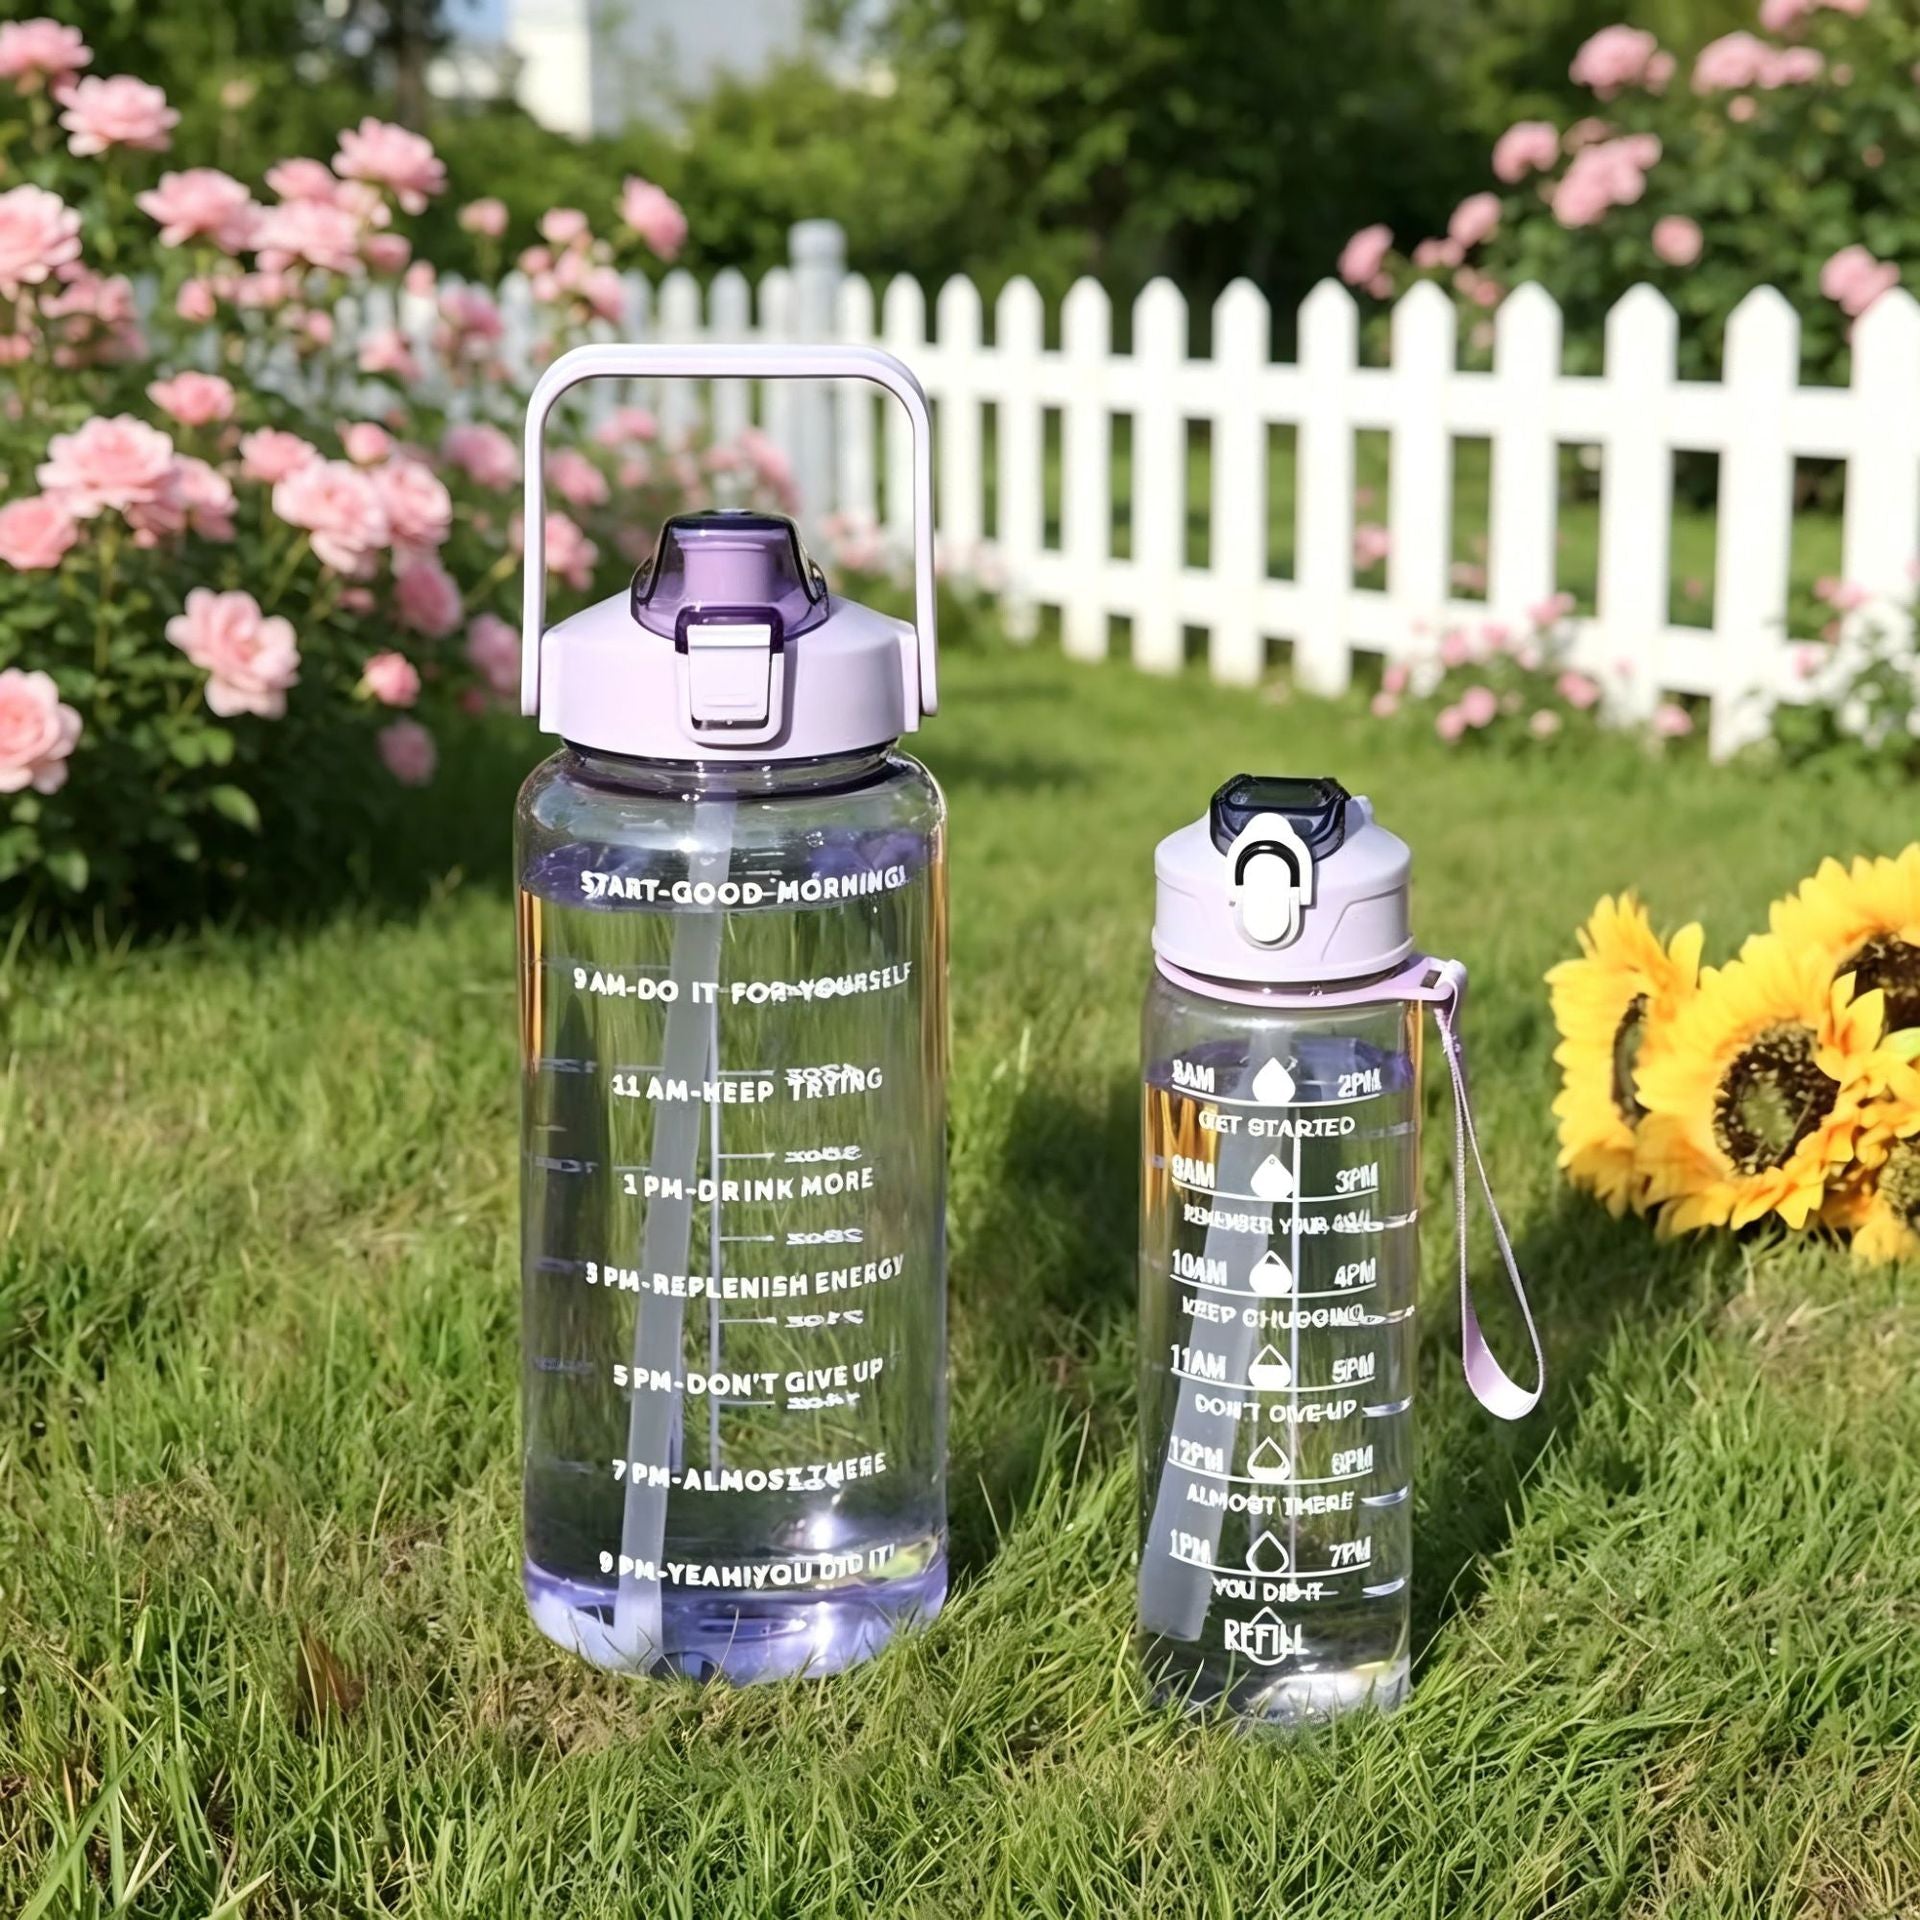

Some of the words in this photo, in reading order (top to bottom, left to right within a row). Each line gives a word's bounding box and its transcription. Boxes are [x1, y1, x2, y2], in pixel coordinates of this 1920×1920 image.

[692, 981, 719, 1004] IT
[1171, 1059, 1215, 1093] 8AM
[1338, 1068, 1382, 1098] 2PM
[1199, 1111, 1243, 1136] GET
[1248, 1116, 1356, 1138] STARTED
[800, 1167, 874, 1198] MORE
[1335, 1162, 1378, 1194] 3PM
[816, 1254, 904, 1294] ENERGY
[1172, 1249, 1228, 1286] 10AM
[1334, 1257, 1376, 1288] 4PM
[785, 1365, 848, 1392] GIVE
[853, 1358, 884, 1383] UP
[1171, 1345, 1227, 1381] 11AM
[1332, 1352, 1375, 1383] 5PM
[1170, 1436, 1224, 1473] 12PM
[1187, 1484, 1275, 1515] ALMOST
[1170, 1529, 1211, 1564] 1PM
[1329, 1536, 1372, 1567] 7PM
[1211, 1573, 1256, 1601] YOU
[1224, 1619, 1309, 1655] REFILL
